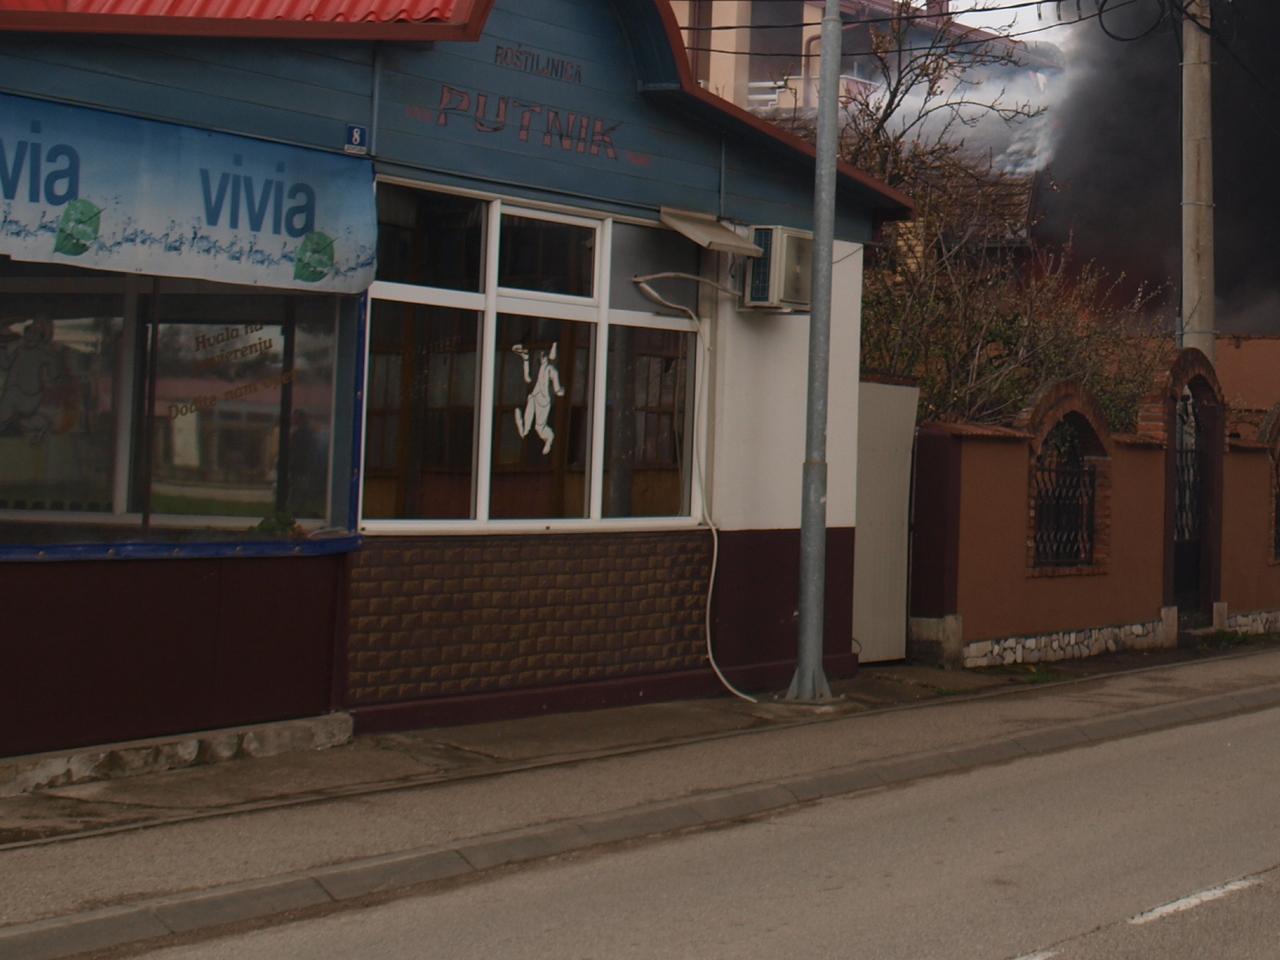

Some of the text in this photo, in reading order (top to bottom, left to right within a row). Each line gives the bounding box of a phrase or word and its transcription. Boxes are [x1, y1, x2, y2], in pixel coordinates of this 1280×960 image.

[351, 127, 361, 145] 8
[436, 84, 624, 159] PUTNIK
[199, 153, 316, 239] vivia
[194, 326, 240, 352] Hvala
